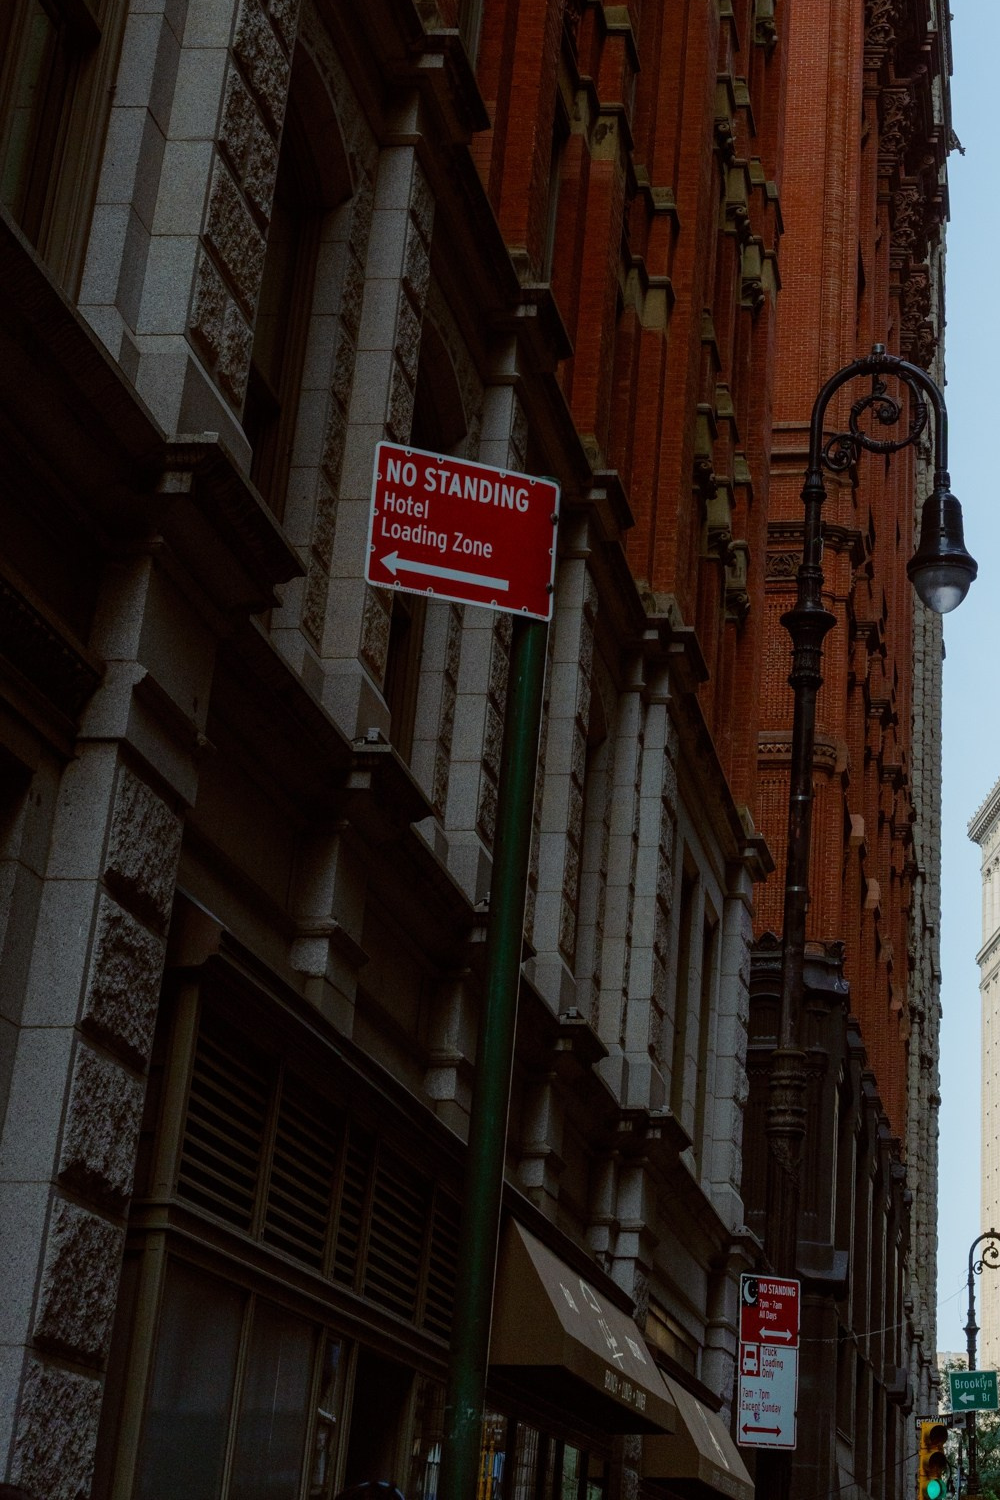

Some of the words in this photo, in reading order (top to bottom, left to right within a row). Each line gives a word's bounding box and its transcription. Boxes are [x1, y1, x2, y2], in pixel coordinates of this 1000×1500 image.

[386, 458, 417, 487] NO
[423, 467, 530, 512] STANDING
[383, 491, 429, 519] Hotel
[381, 517, 448, 553] Loading
[452, 532, 493, 559] Zone
[759, 1283, 768, 1294] NO
[768, 1284, 796, 1298] STANDING
[759, 1299, 769, 1309] 7pm
[772, 1300, 783, 1310] 7am
[766, 1311, 778, 1321] Days
[763, 1346, 778, 1357] Truck
[763, 1357, 784, 1370] Loading
[763, 1368, 775, 1381] Only
[955, 1378, 993, 1391] Brooklyn
[743, 1387, 754, 1399] 7am
[759, 1389, 770, 1400] 7pm
[982, 1393, 991, 1402] Br
[742, 1401, 761, 1414] Except
[762, 1402, 781, 1418] Sunday
